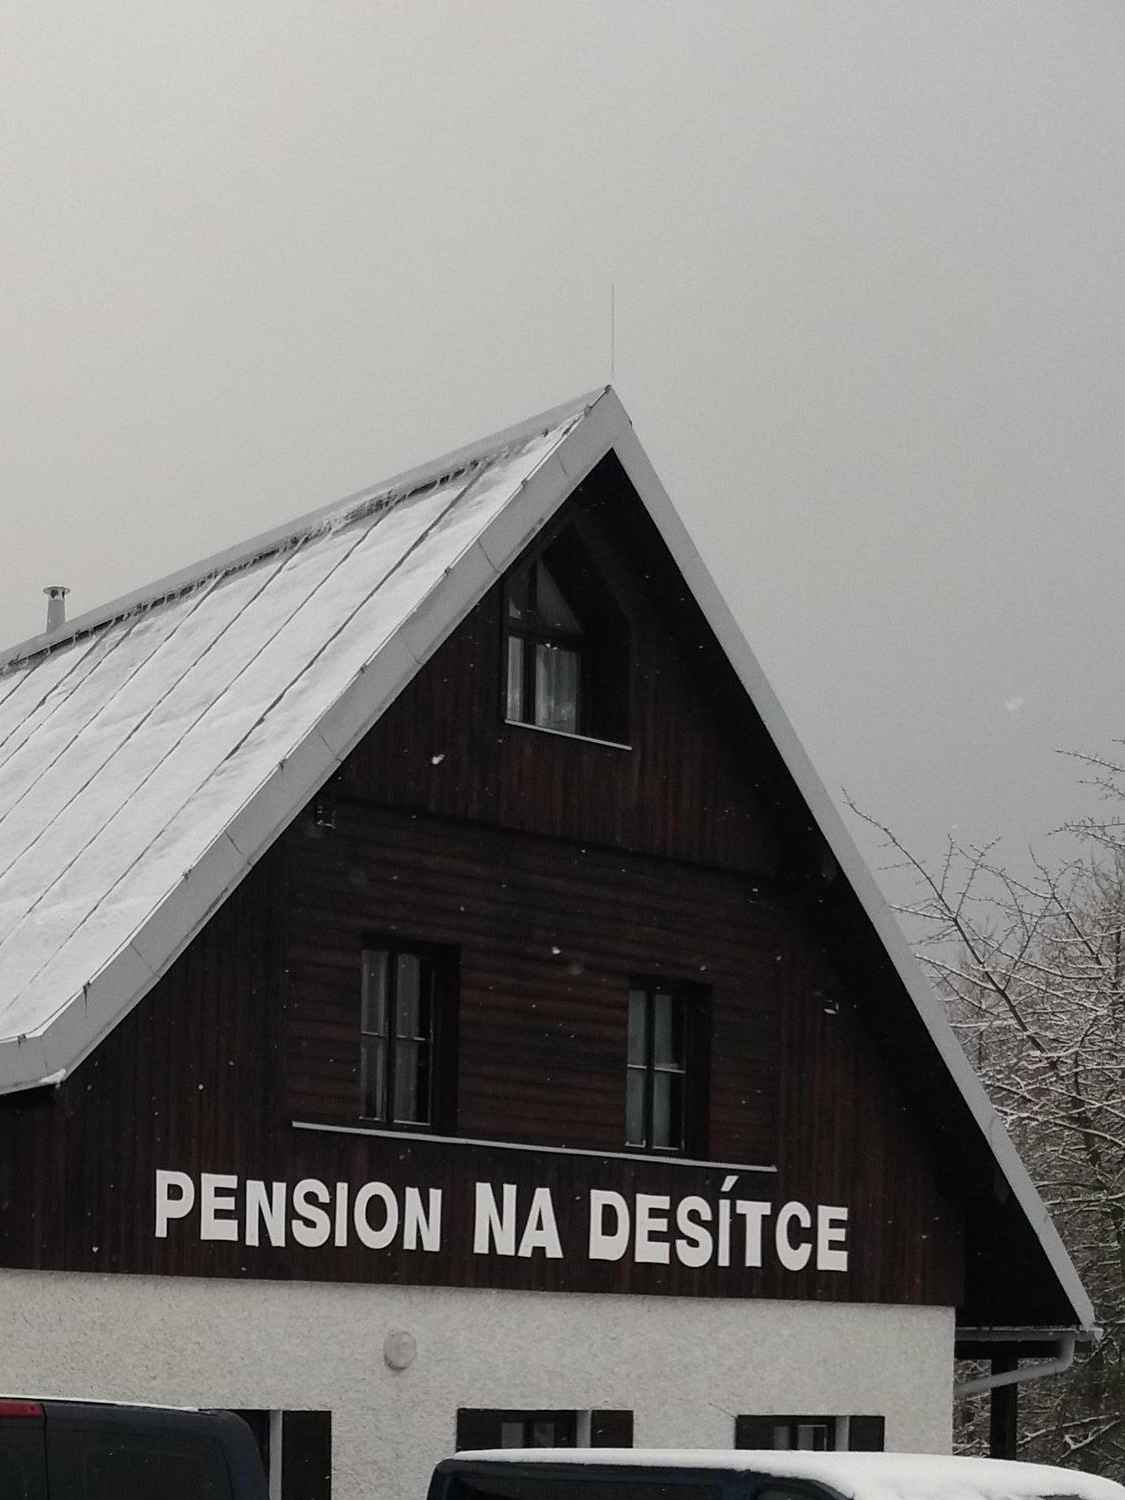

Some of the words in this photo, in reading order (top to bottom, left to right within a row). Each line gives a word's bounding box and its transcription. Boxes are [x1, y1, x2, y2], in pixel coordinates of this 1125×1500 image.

[155, 1169, 443, 1252] PENSION
[473, 1181, 564, 1259] NA
[588, 1175, 849, 1272] DESÍTCE
